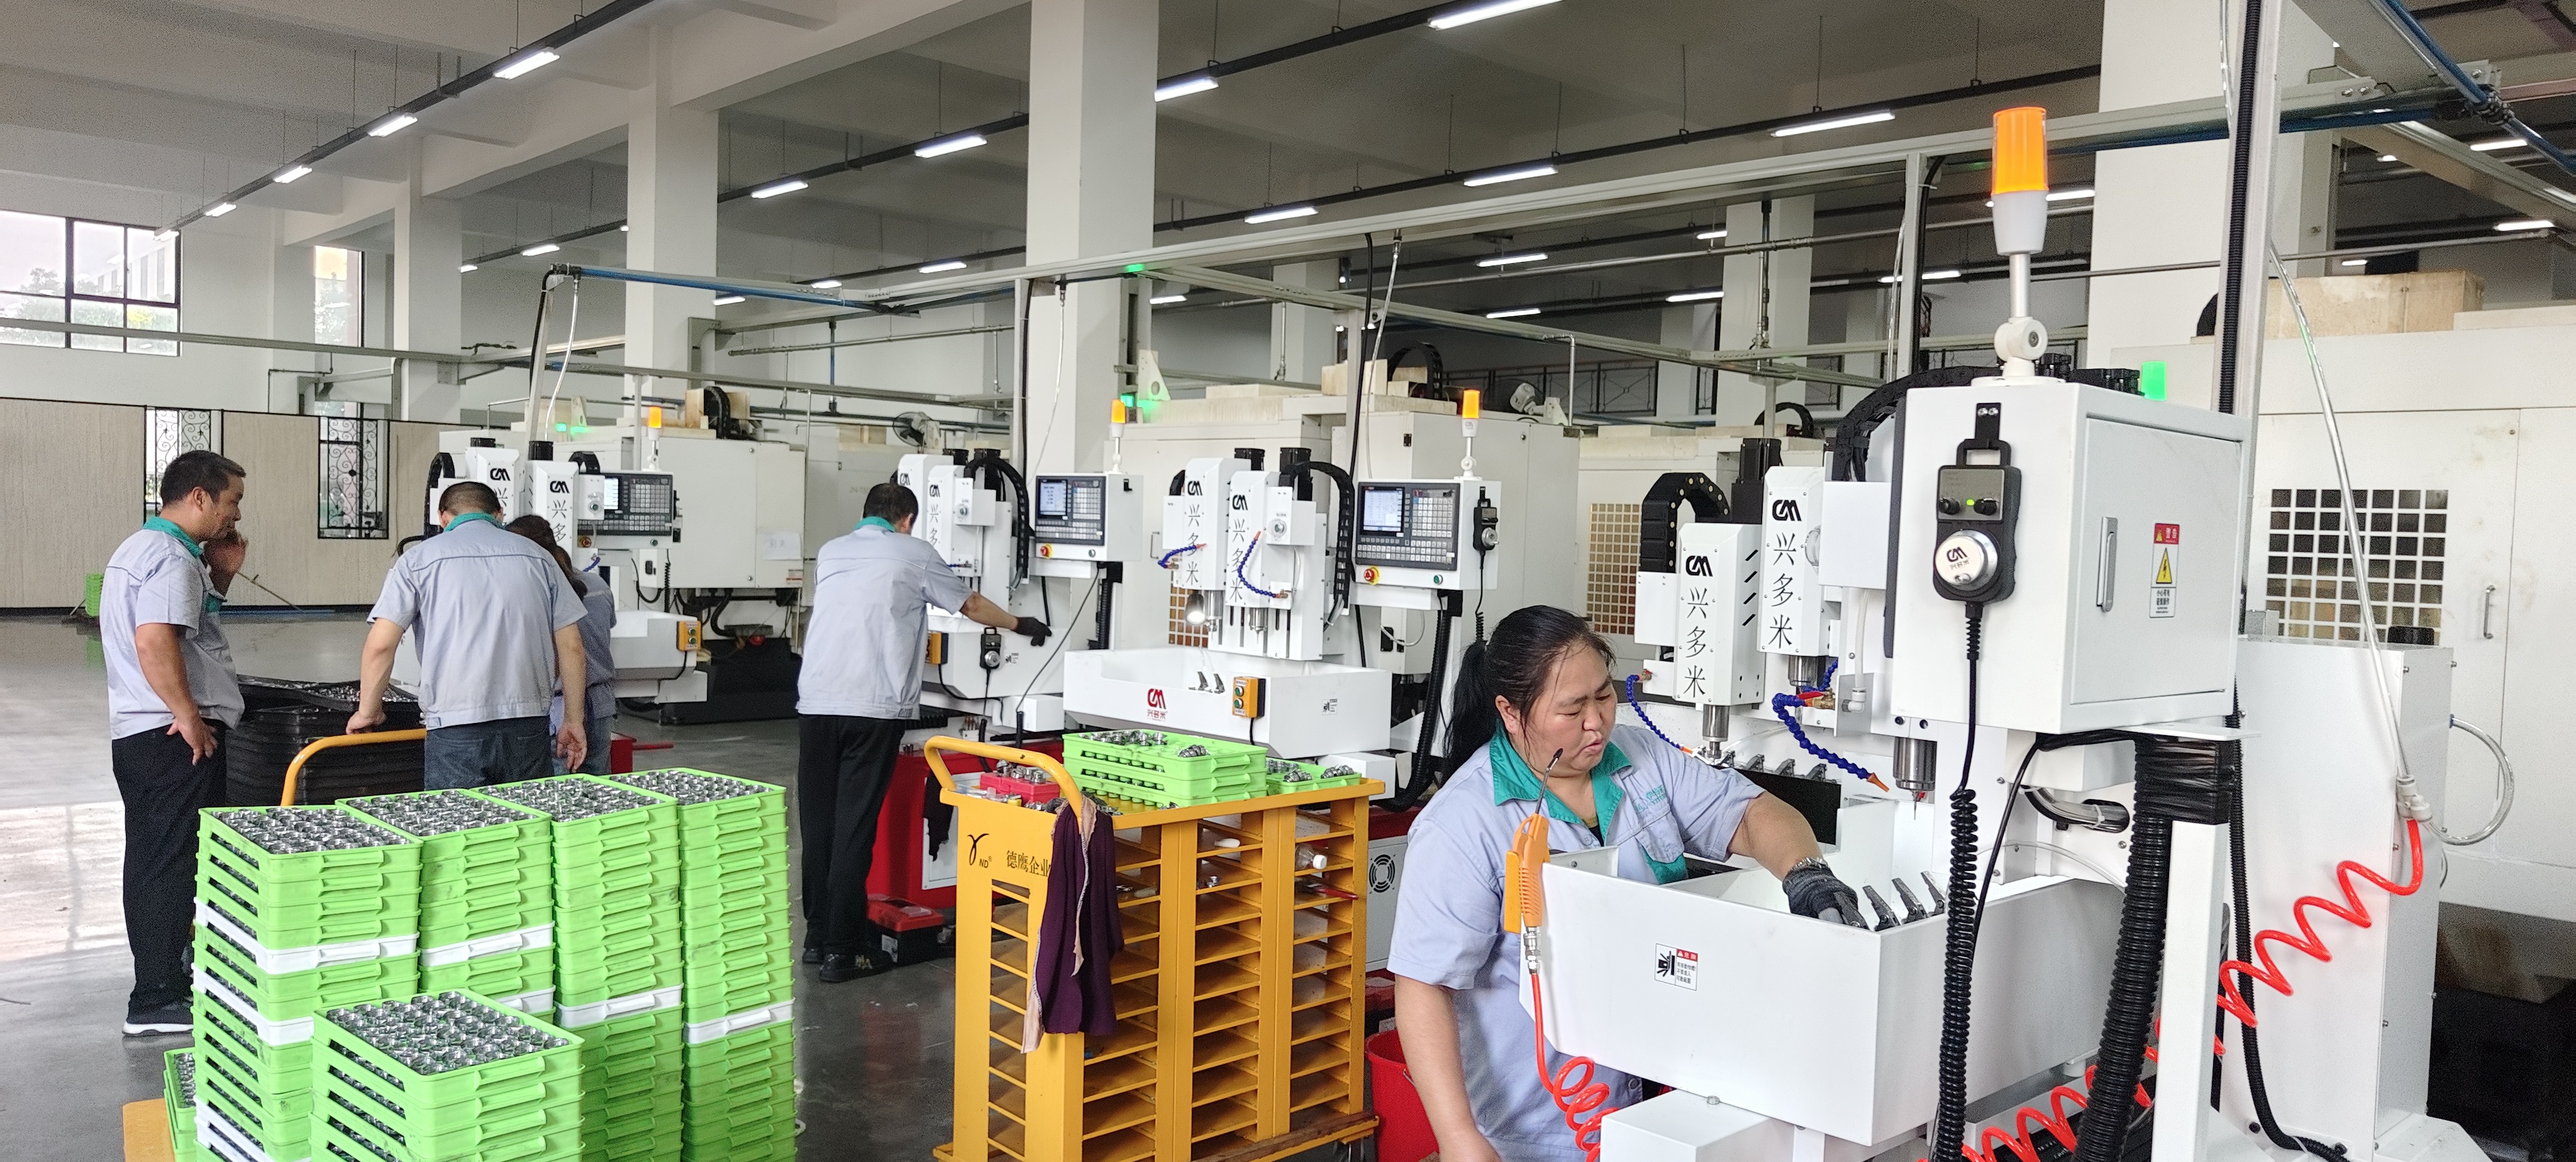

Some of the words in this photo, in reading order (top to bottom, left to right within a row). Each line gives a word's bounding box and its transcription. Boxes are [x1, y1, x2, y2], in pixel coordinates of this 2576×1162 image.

[1185, 504, 1201, 585] 兴多米
[1230, 518, 1246, 603] 兴多米
[1768, 531, 1797, 650] 兴多米
[1684, 586, 1709, 699] 兴多米
[1006, 849, 1052, 877] 德鹰企业
